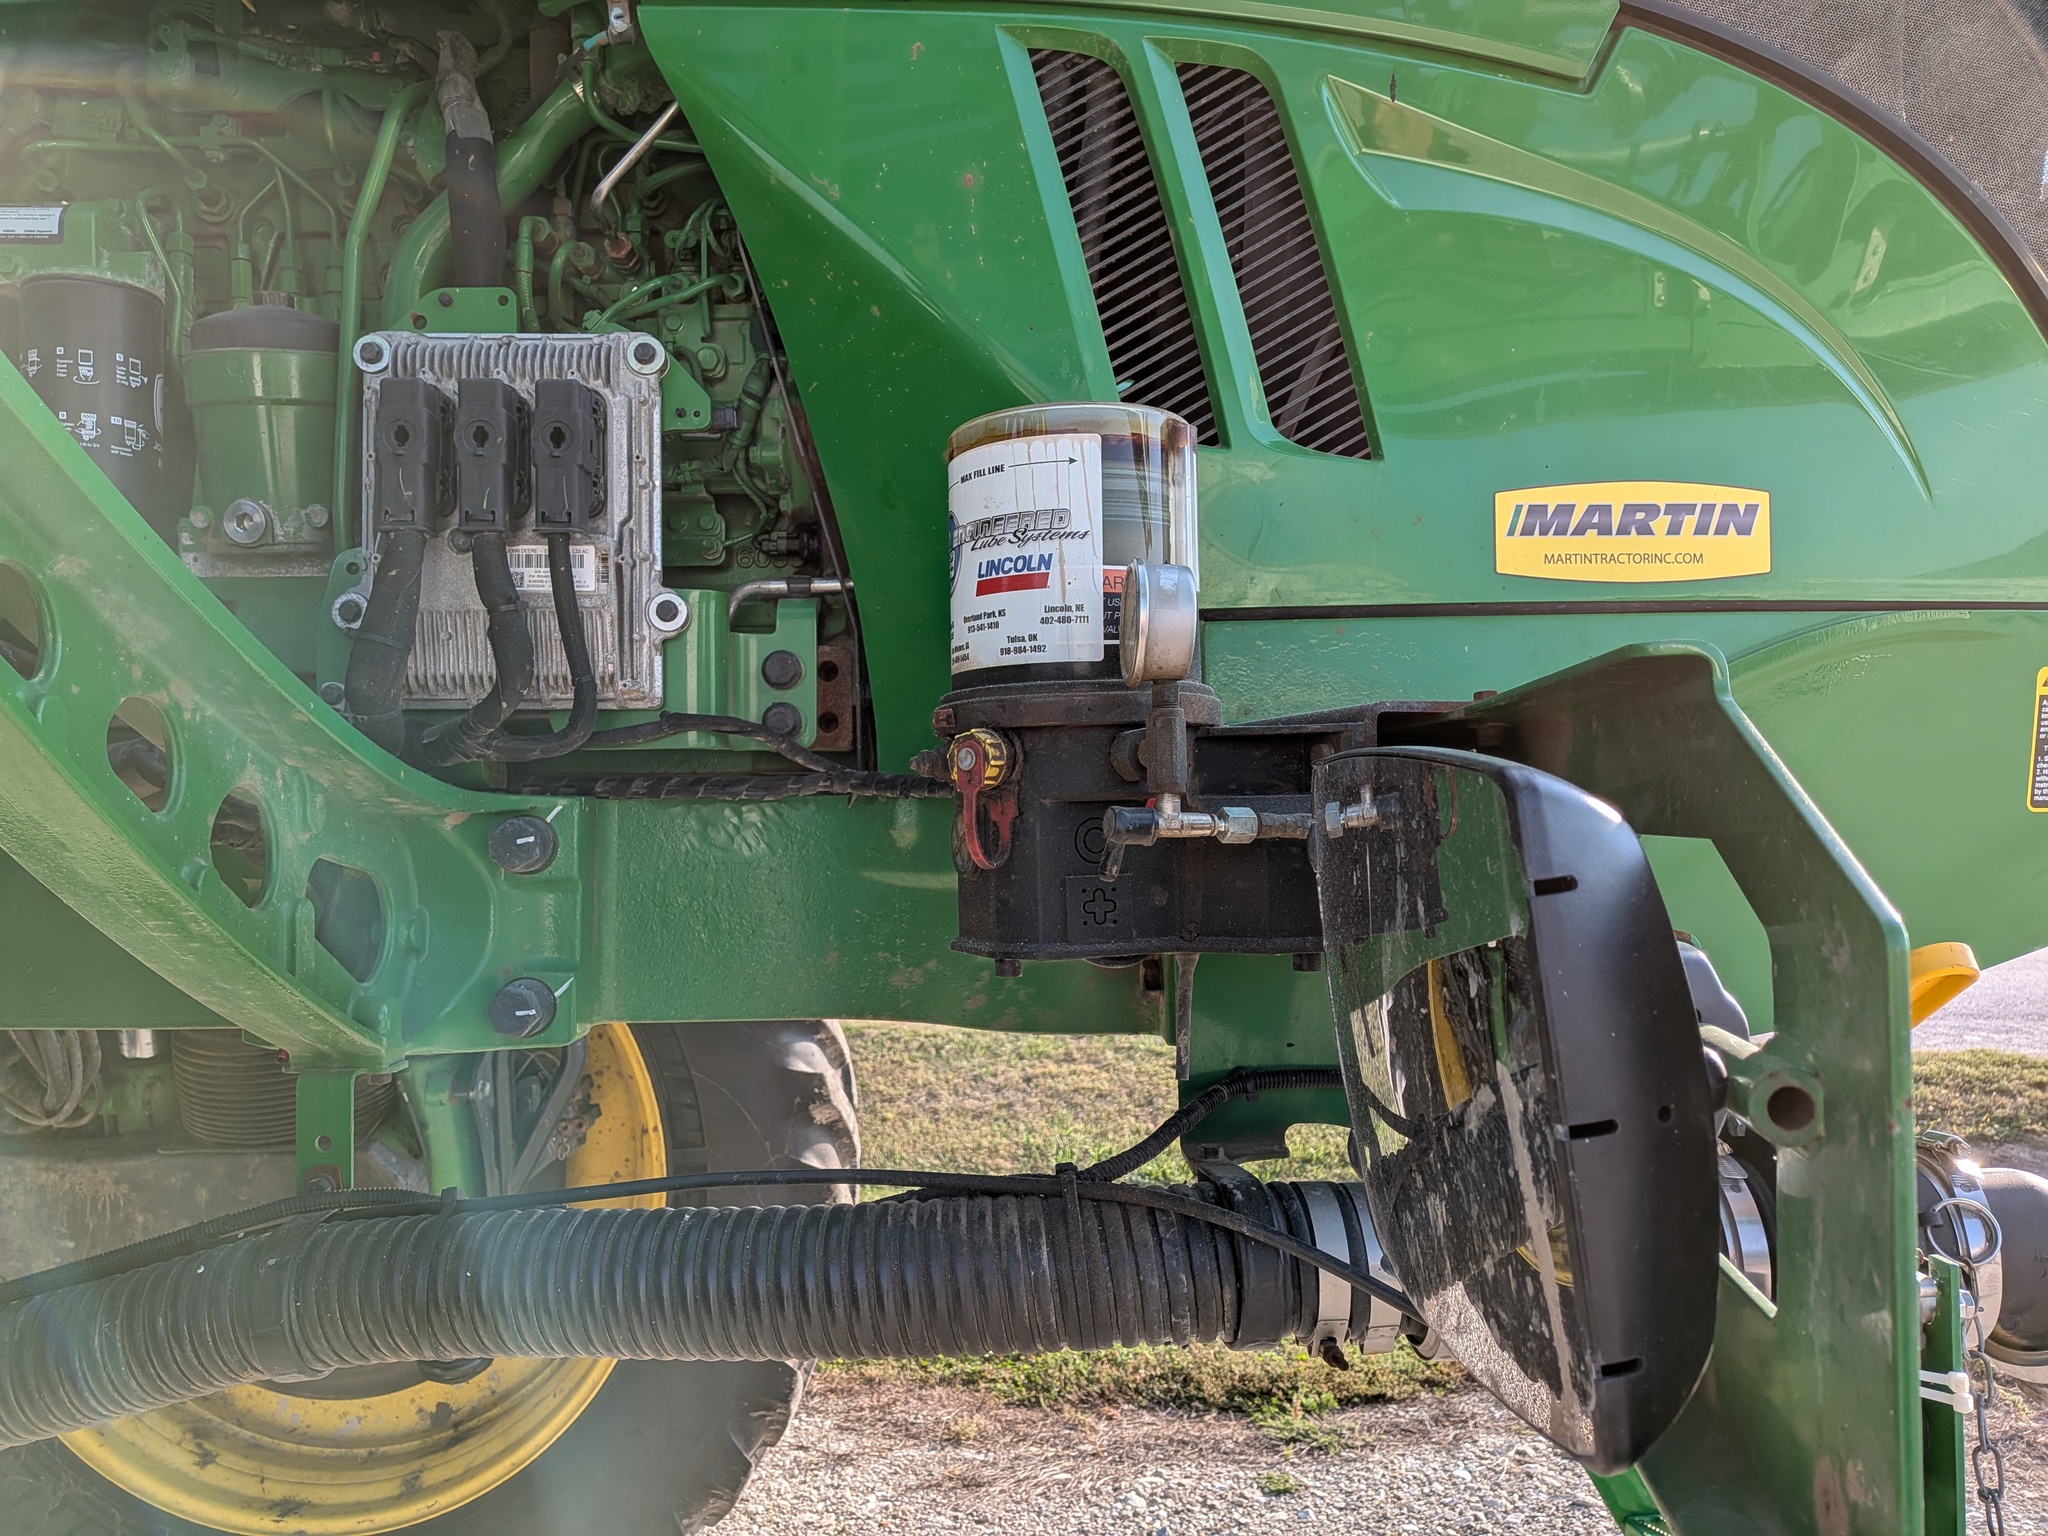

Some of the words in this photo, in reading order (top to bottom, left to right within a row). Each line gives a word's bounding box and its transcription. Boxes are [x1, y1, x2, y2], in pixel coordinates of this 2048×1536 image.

[960, 472, 972, 484] MAX
[974, 467, 987, 479] FILL
[988, 464, 1005, 475] LINE
[1518, 502, 1760, 538] MARTIN
[971, 536, 1006, 551] Lube
[1008, 528, 1090, 548] Systems
[977, 553, 1053, 578] LINCOLN
[1544, 552, 1704, 565] MARTINTRACTORINC.COM
[1044, 604, 1074, 613] Lincoln,
[1075, 604, 1085, 612] NE
[963, 613, 982, 624] Overland
[998, 609, 1007, 617] KS
[1040, 615, 1089, 625] 402-480-7111
[1006, 634, 1027, 644] Tulsa,
[1028, 633, 1038, 642] OK
[1000, 644, 1046, 656] 918-984-1492
